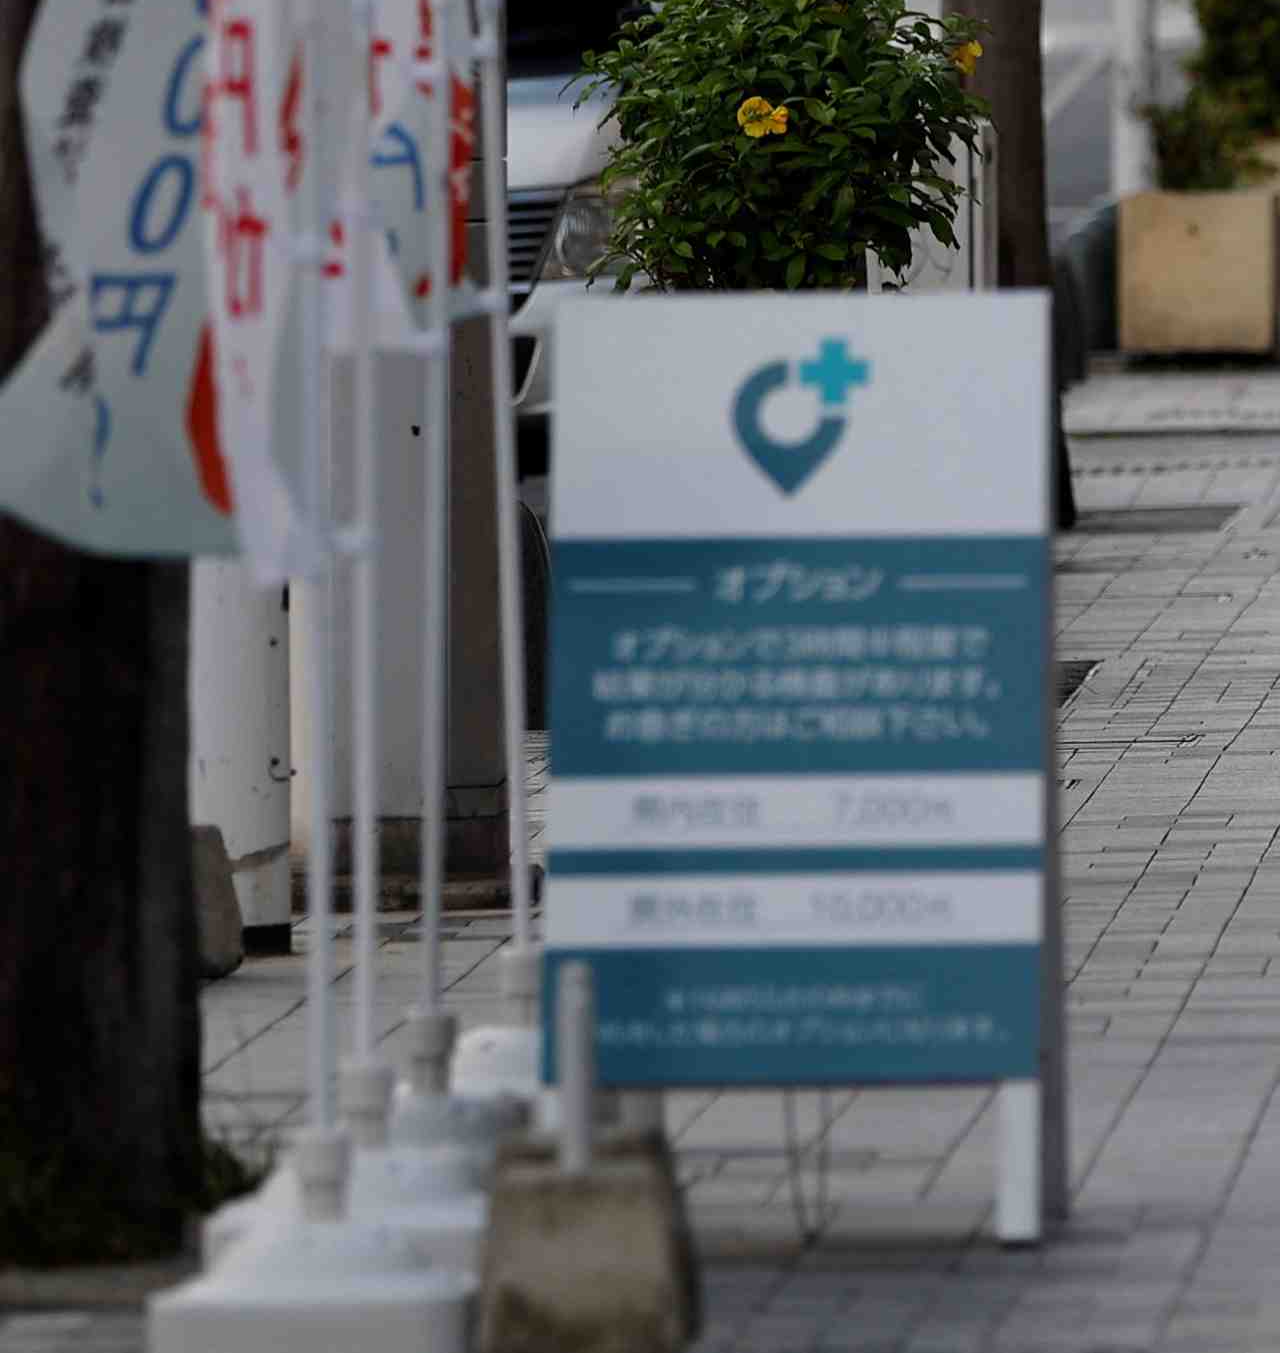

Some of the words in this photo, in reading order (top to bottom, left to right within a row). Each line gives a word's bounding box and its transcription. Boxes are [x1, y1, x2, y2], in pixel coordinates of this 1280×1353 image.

[714, 563, 883, 604] オプション
